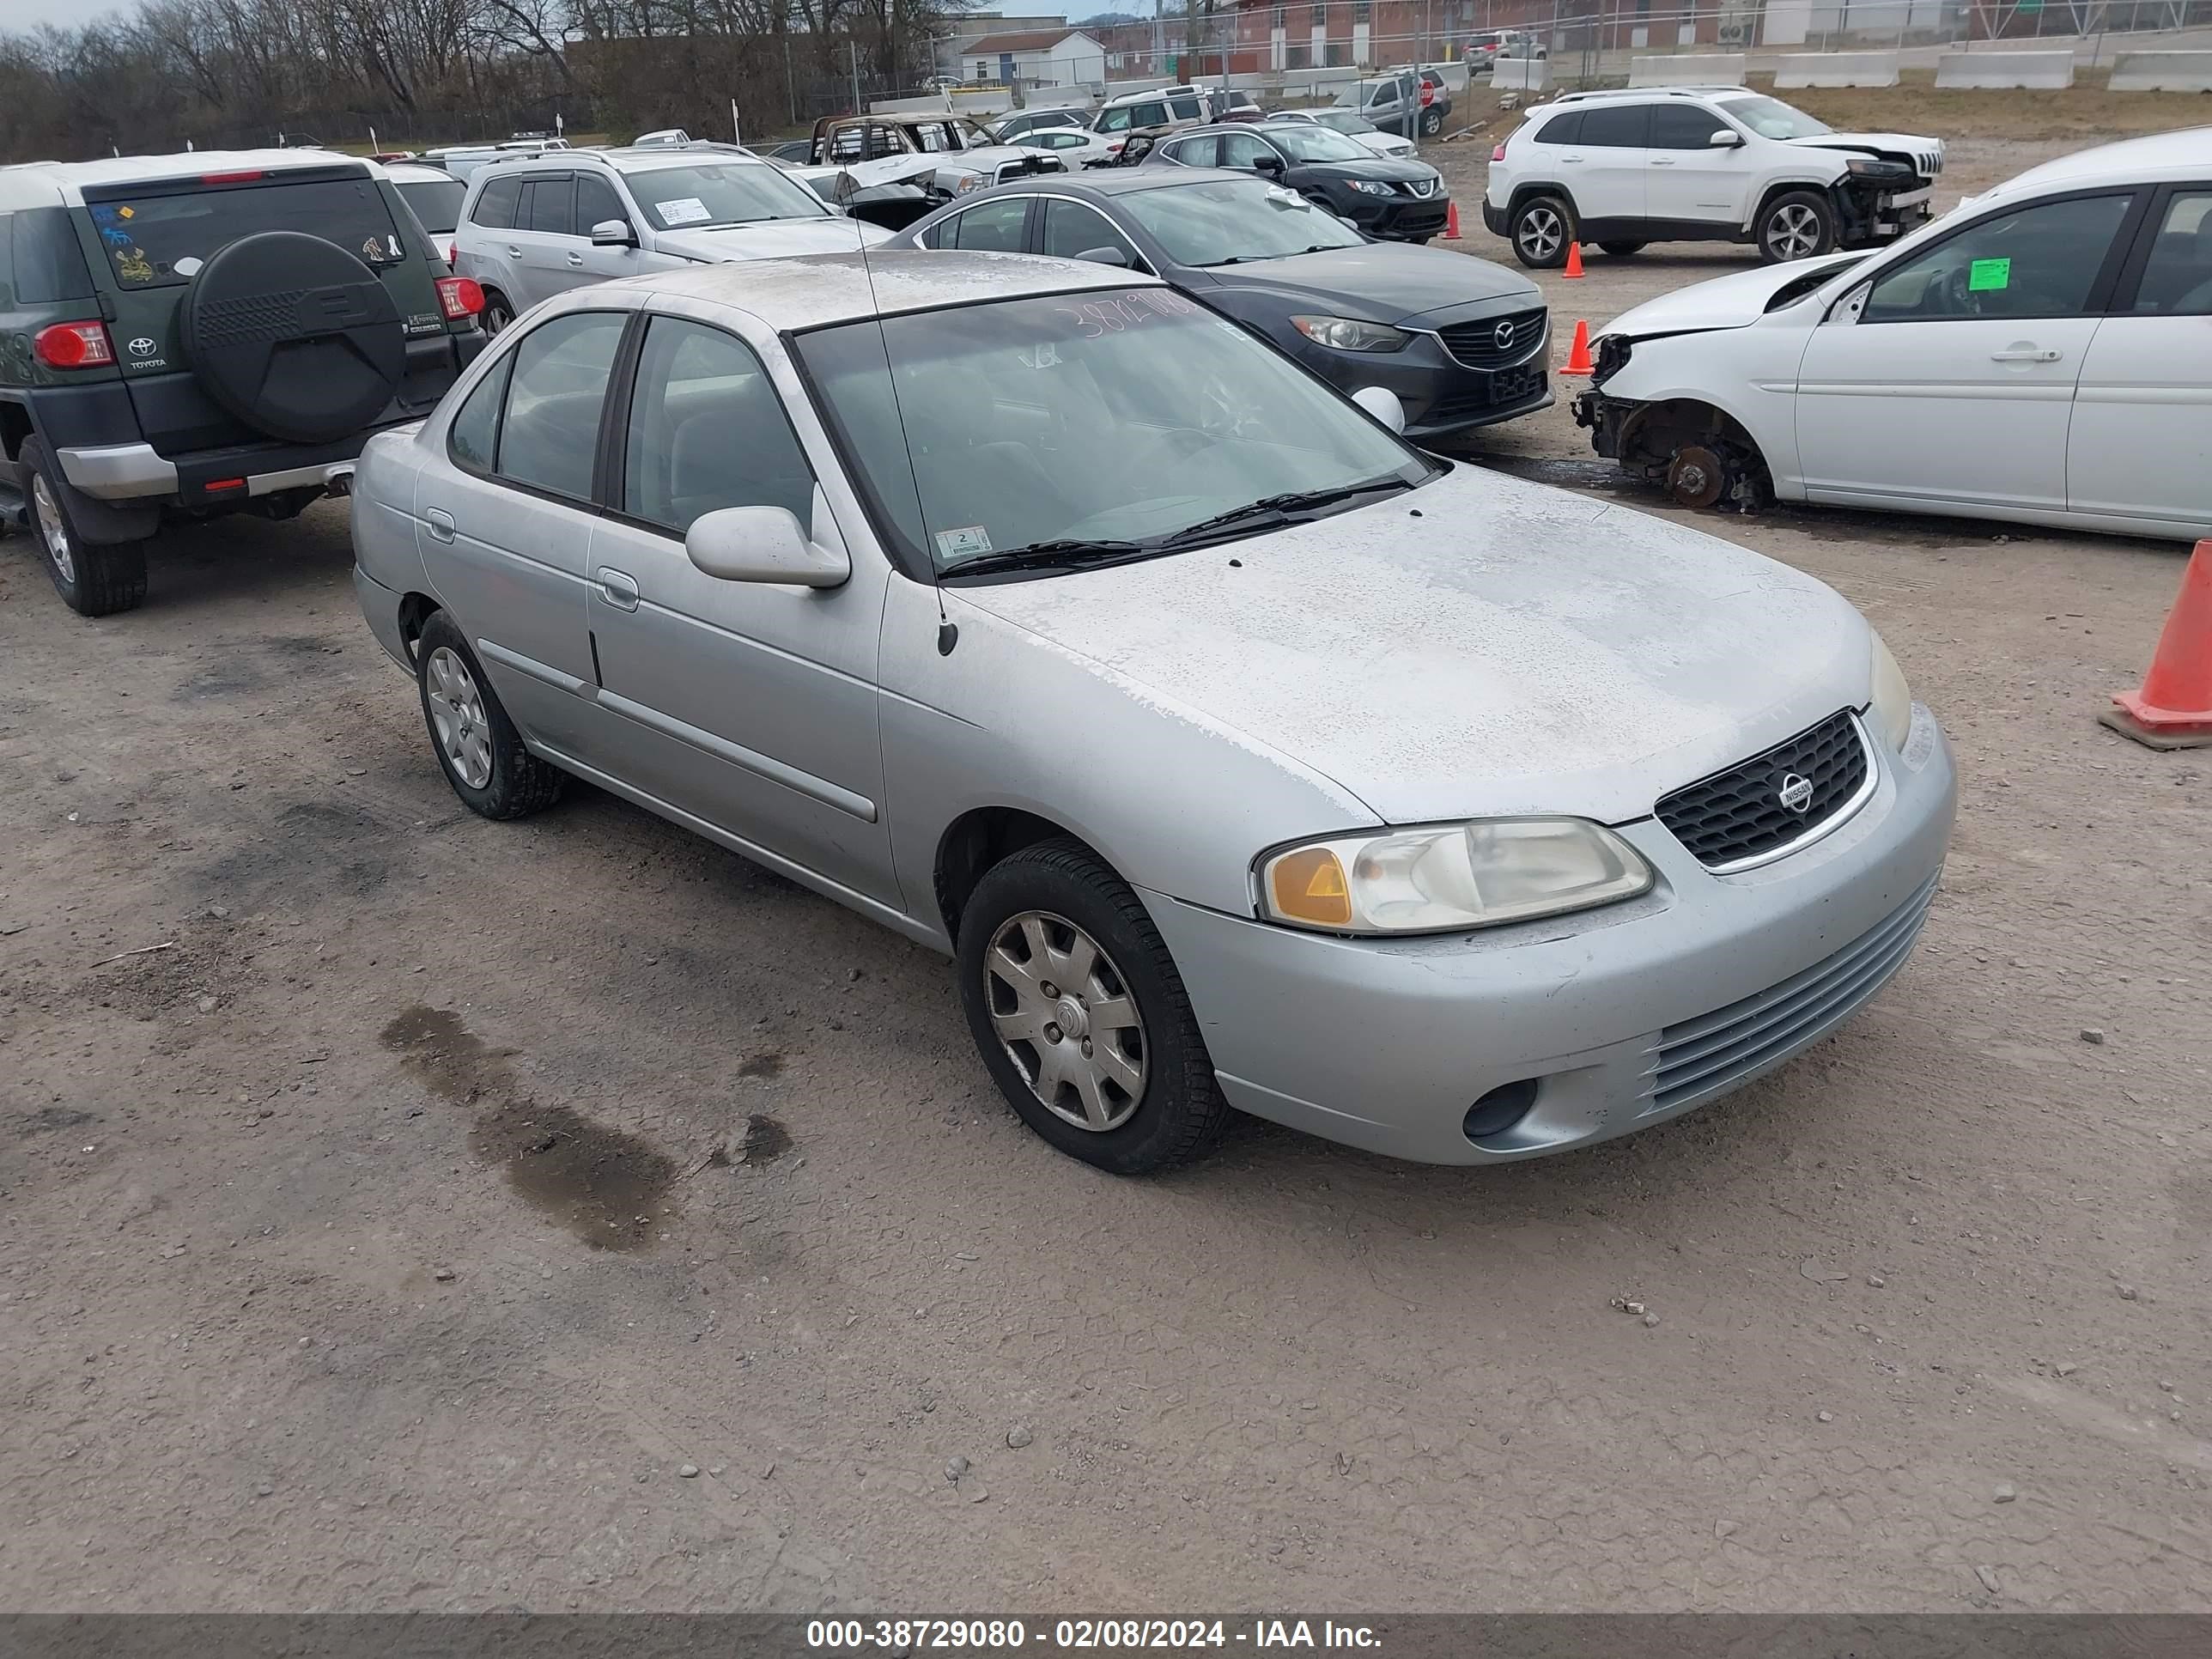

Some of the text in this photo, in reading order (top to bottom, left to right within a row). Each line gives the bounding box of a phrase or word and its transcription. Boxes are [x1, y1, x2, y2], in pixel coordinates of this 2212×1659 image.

[1421, 88, 1434, 98] STOP
[130, 359, 167, 369] TOYOTA
[958, 534, 968, 543] 2
[1785, 781, 1811, 803] NISSAN
